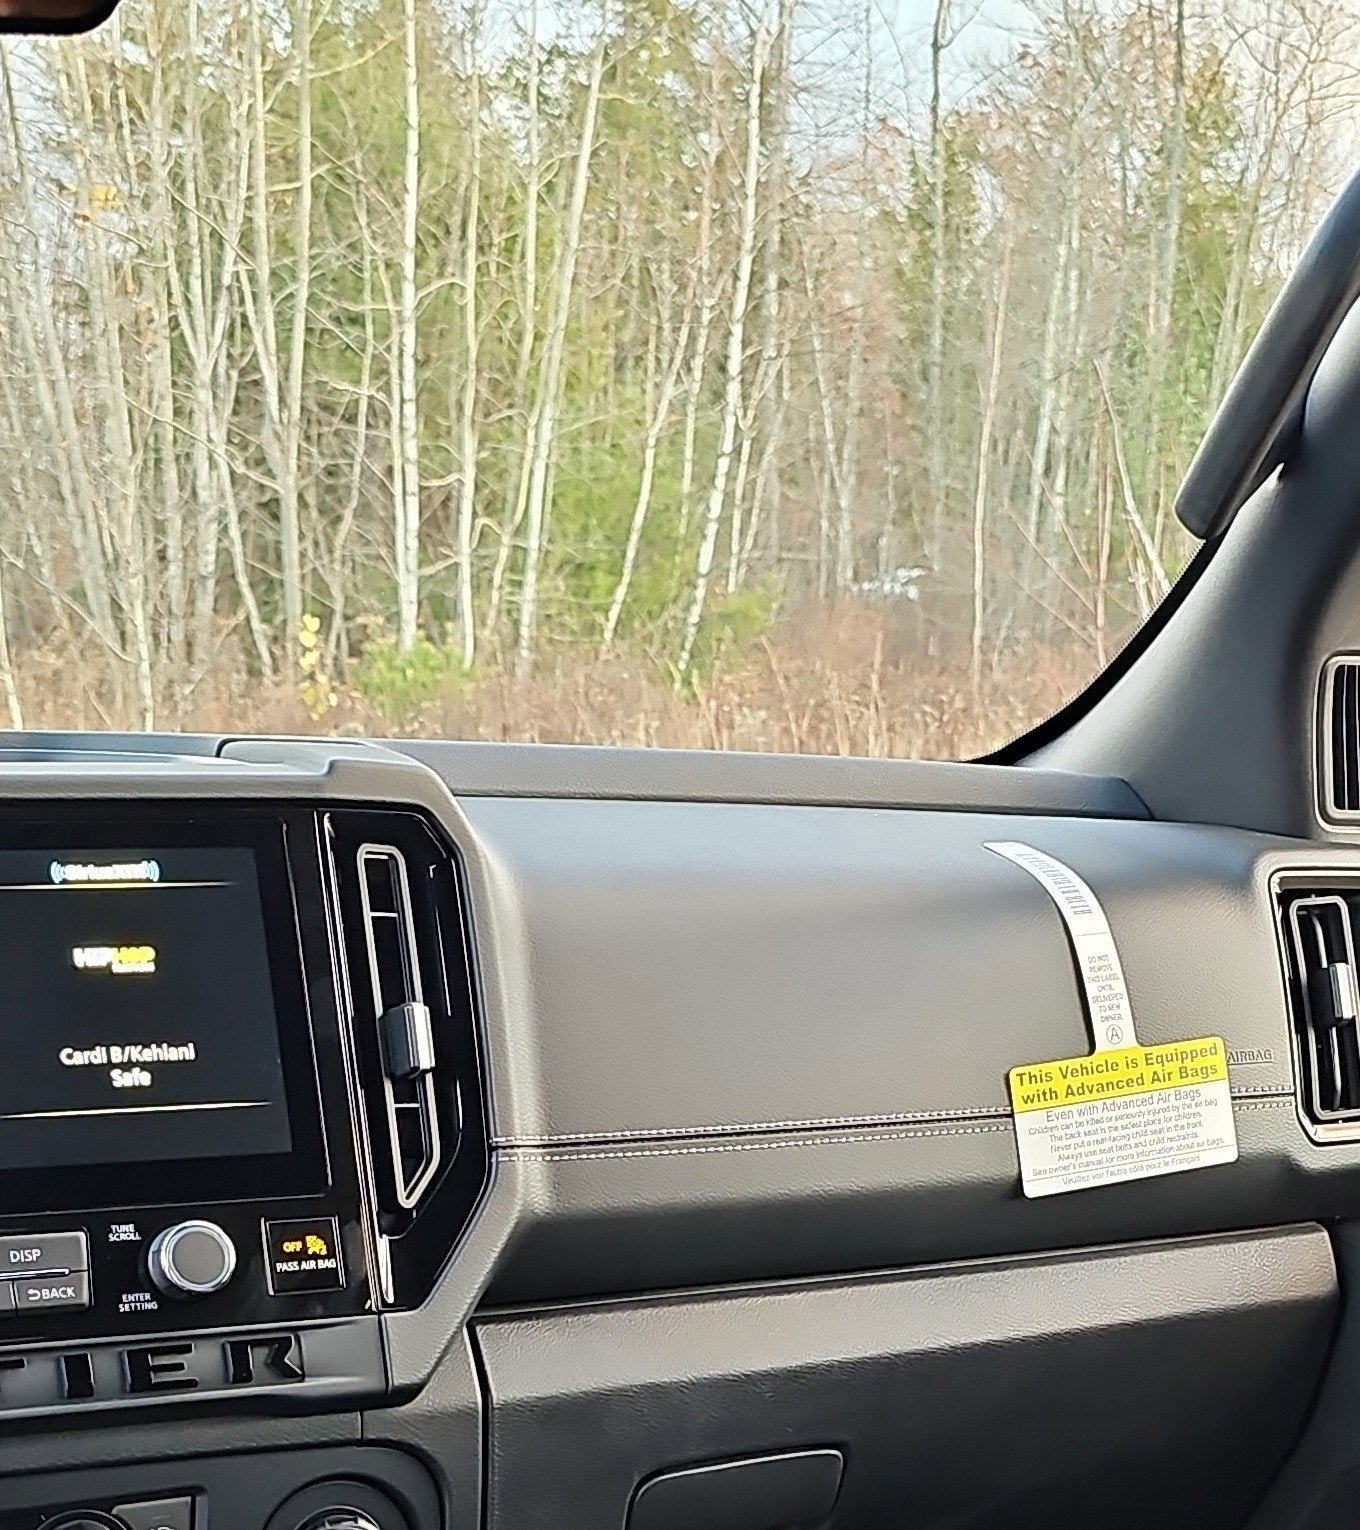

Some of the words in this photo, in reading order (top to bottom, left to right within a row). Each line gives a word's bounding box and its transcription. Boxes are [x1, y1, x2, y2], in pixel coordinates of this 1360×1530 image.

[1110, 1027, 1120, 1041] A
[60, 1046, 108, 1066] Cardi
[110, 1042, 196, 1063] B/Kehlani
[1226, 1049, 1273, 1063] AIRBAG
[1016, 1070, 1053, 1087] This
[1058, 1059, 1120, 1081] Vehicle
[1125, 1056, 1139, 1070] is
[1145, 1043, 1218, 1067] Equipped
[110, 1068, 152, 1087] Safe
[1021, 1088, 1059, 1105] with
[1065, 1073, 1146, 1099] Advanced
[1151, 1070, 1174, 1085] Air
[1179, 1063, 1218, 1080] Bags
[1046, 1110, 1075, 1122] Even
[1077, 1105, 1099, 1117] with
[1101, 1096, 1155, 1113] Advanced
[1157, 1094, 1172, 1106] Air
[1174, 1088, 1202, 1103] Bags
[109, 1223, 136, 1234] TUNE
[108, 1230, 142, 1243] SCROLL
[282, 1241, 303, 1253] OFF
[9, 1248, 41, 1264] DISP
[276, 1261, 299, 1273] PASS
[300, 1259, 317, 1271] AIR
[317, 1258, 337, 1270] BAG
[41, 1284, 76, 1301] BACK
[121, 1292, 151, 1303] ENTER
[118, 1299, 158, 1312] SETTING
